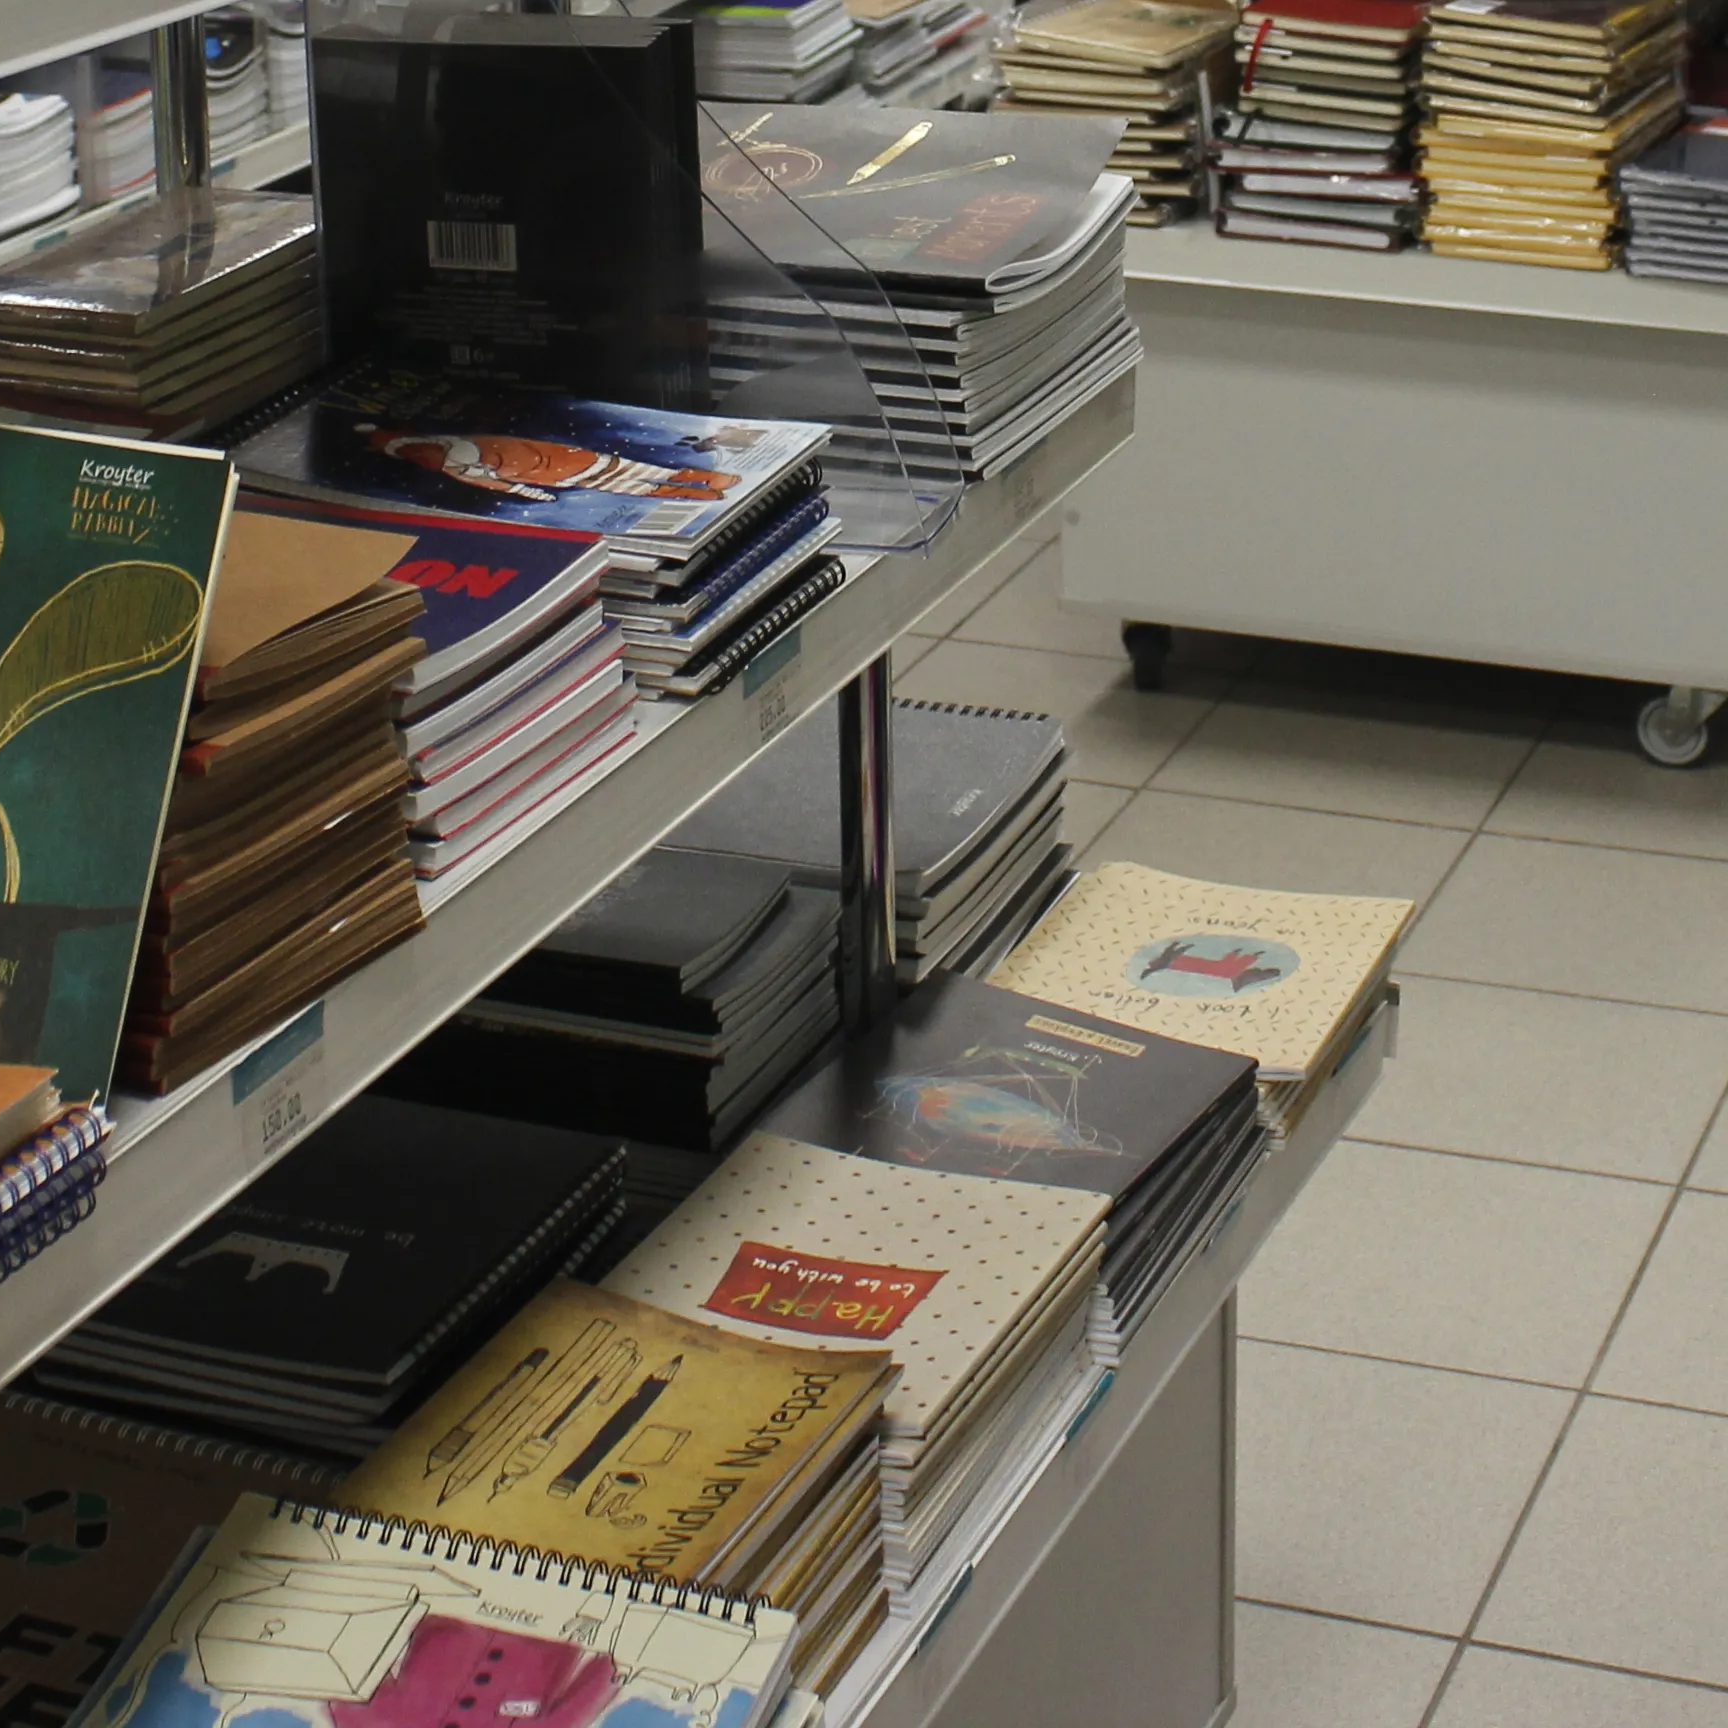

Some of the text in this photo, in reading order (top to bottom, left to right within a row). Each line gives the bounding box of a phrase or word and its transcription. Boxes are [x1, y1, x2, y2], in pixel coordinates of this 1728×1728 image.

[79, 458, 156, 485] Kroyter
[262, 1091, 302, 1143] 150.00
[752, 1256, 916, 1299] to be with you
[730, 1281, 895, 1332] Happy
[714, 1367, 840, 1469] Notepad
[476, 1601, 544, 1628] Kroyter
